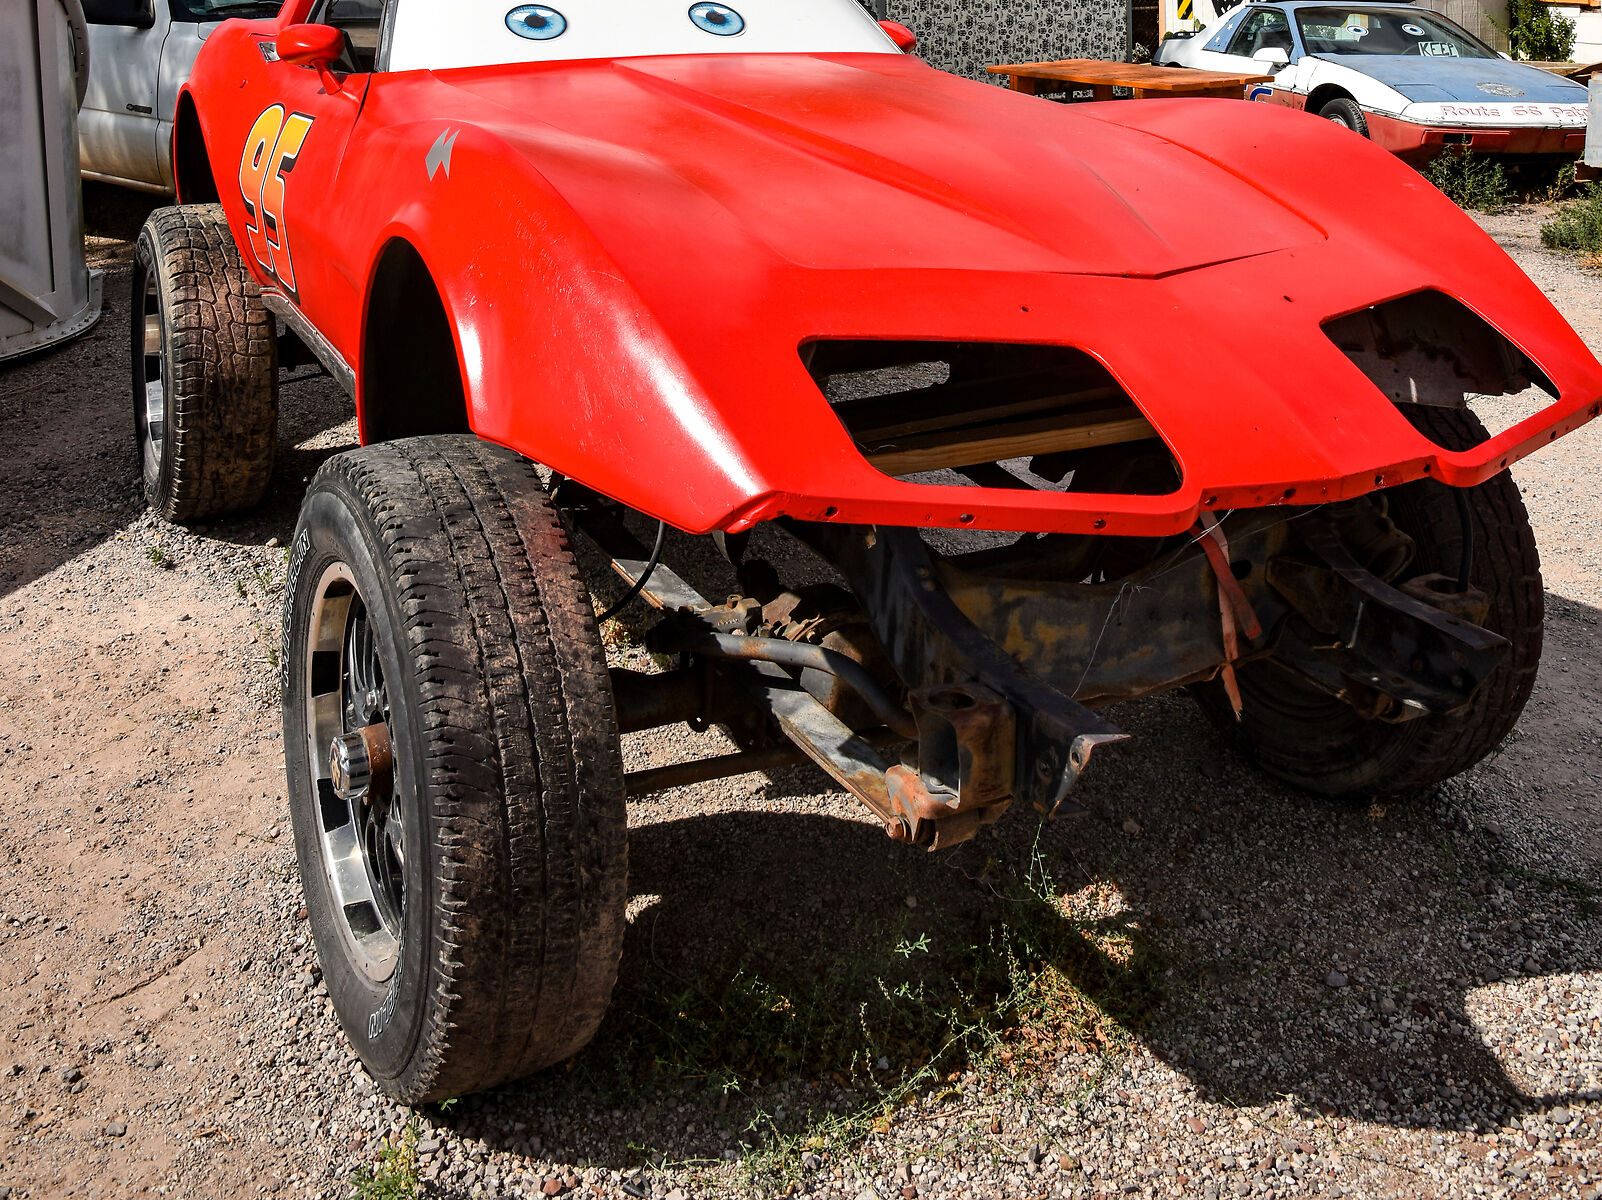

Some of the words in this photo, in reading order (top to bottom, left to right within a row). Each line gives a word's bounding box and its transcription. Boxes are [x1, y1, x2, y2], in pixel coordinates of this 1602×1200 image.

[1420, 42, 1454, 57] KEEP
[1440, 105, 1501, 117] Route
[1511, 105, 1543, 117] 66
[239, 103, 315, 298] 95
[281, 528, 311, 688] MICHELIN
